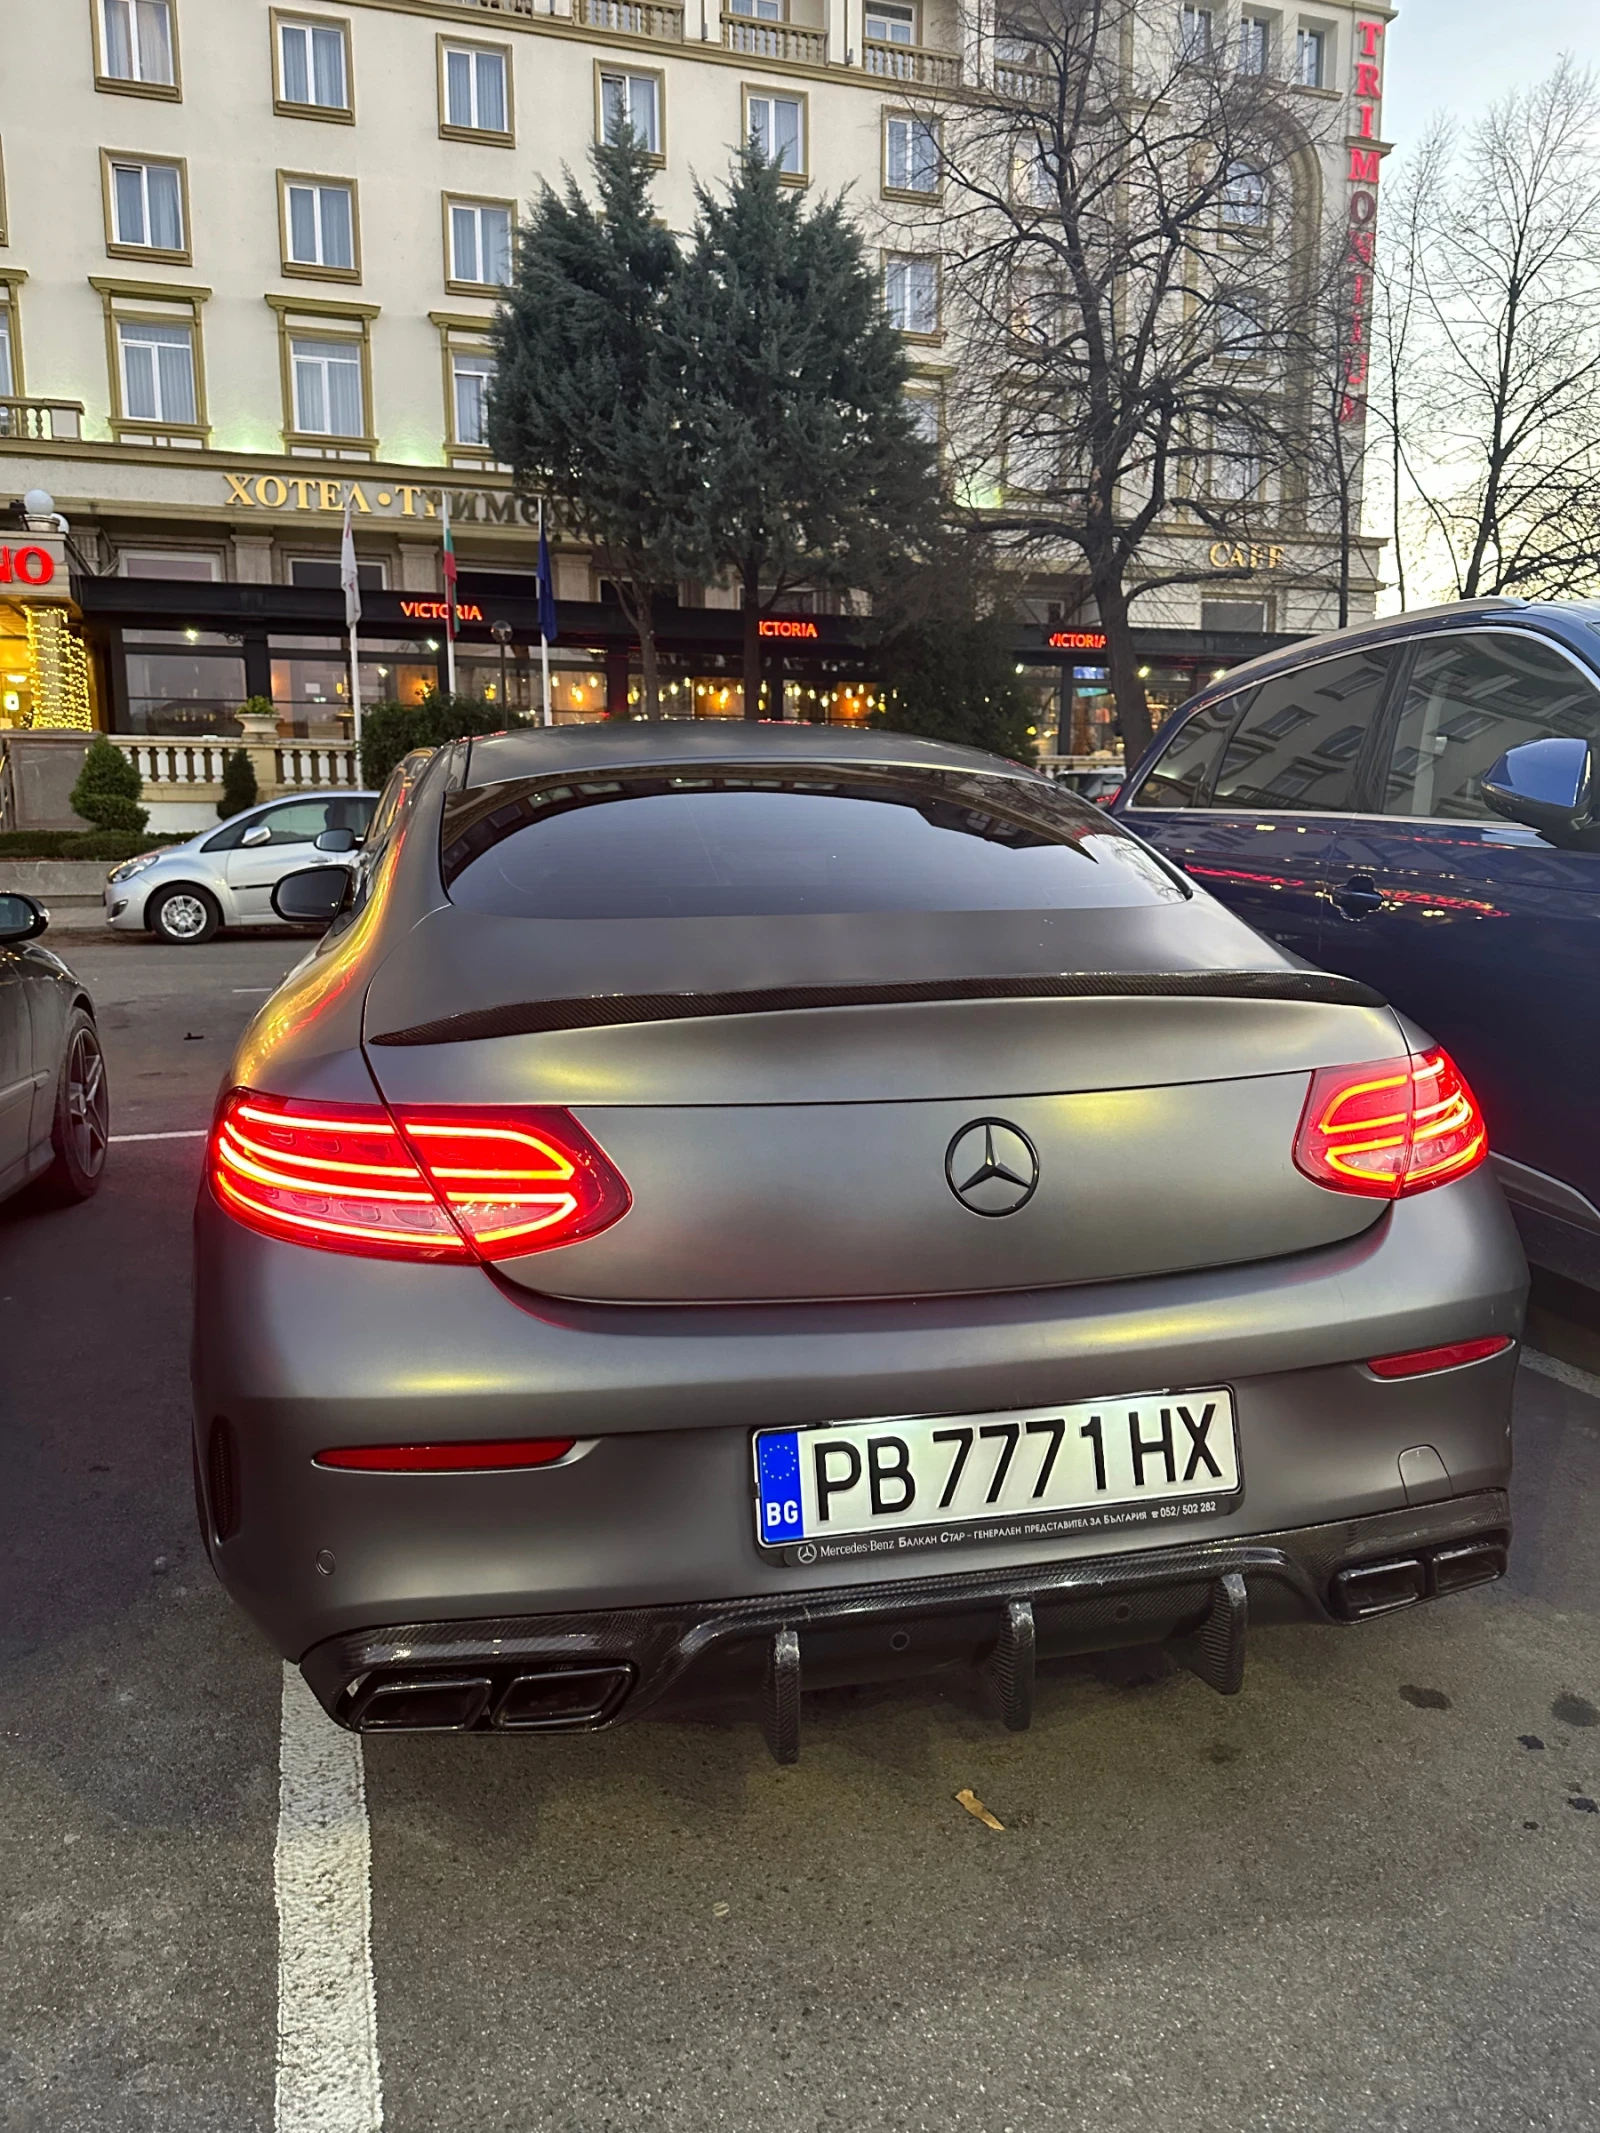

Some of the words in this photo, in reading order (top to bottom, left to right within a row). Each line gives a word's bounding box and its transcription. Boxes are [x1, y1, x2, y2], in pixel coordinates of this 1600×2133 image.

[223, 473, 372, 513] ХОТЕЛ
[400, 601, 483, 621] VICTORIA
[766, 1500, 799, 1527] BG
[813, 1435, 916, 1522] PB
[932, 1415, 1107, 1509] 7771
[1128, 1403, 1223, 1486] HX
[820, 1539, 895, 1557] Mercedes-Benz
[1182, 1503, 1199, 1515] 502
[1200, 1501, 1216, 1513] 282
